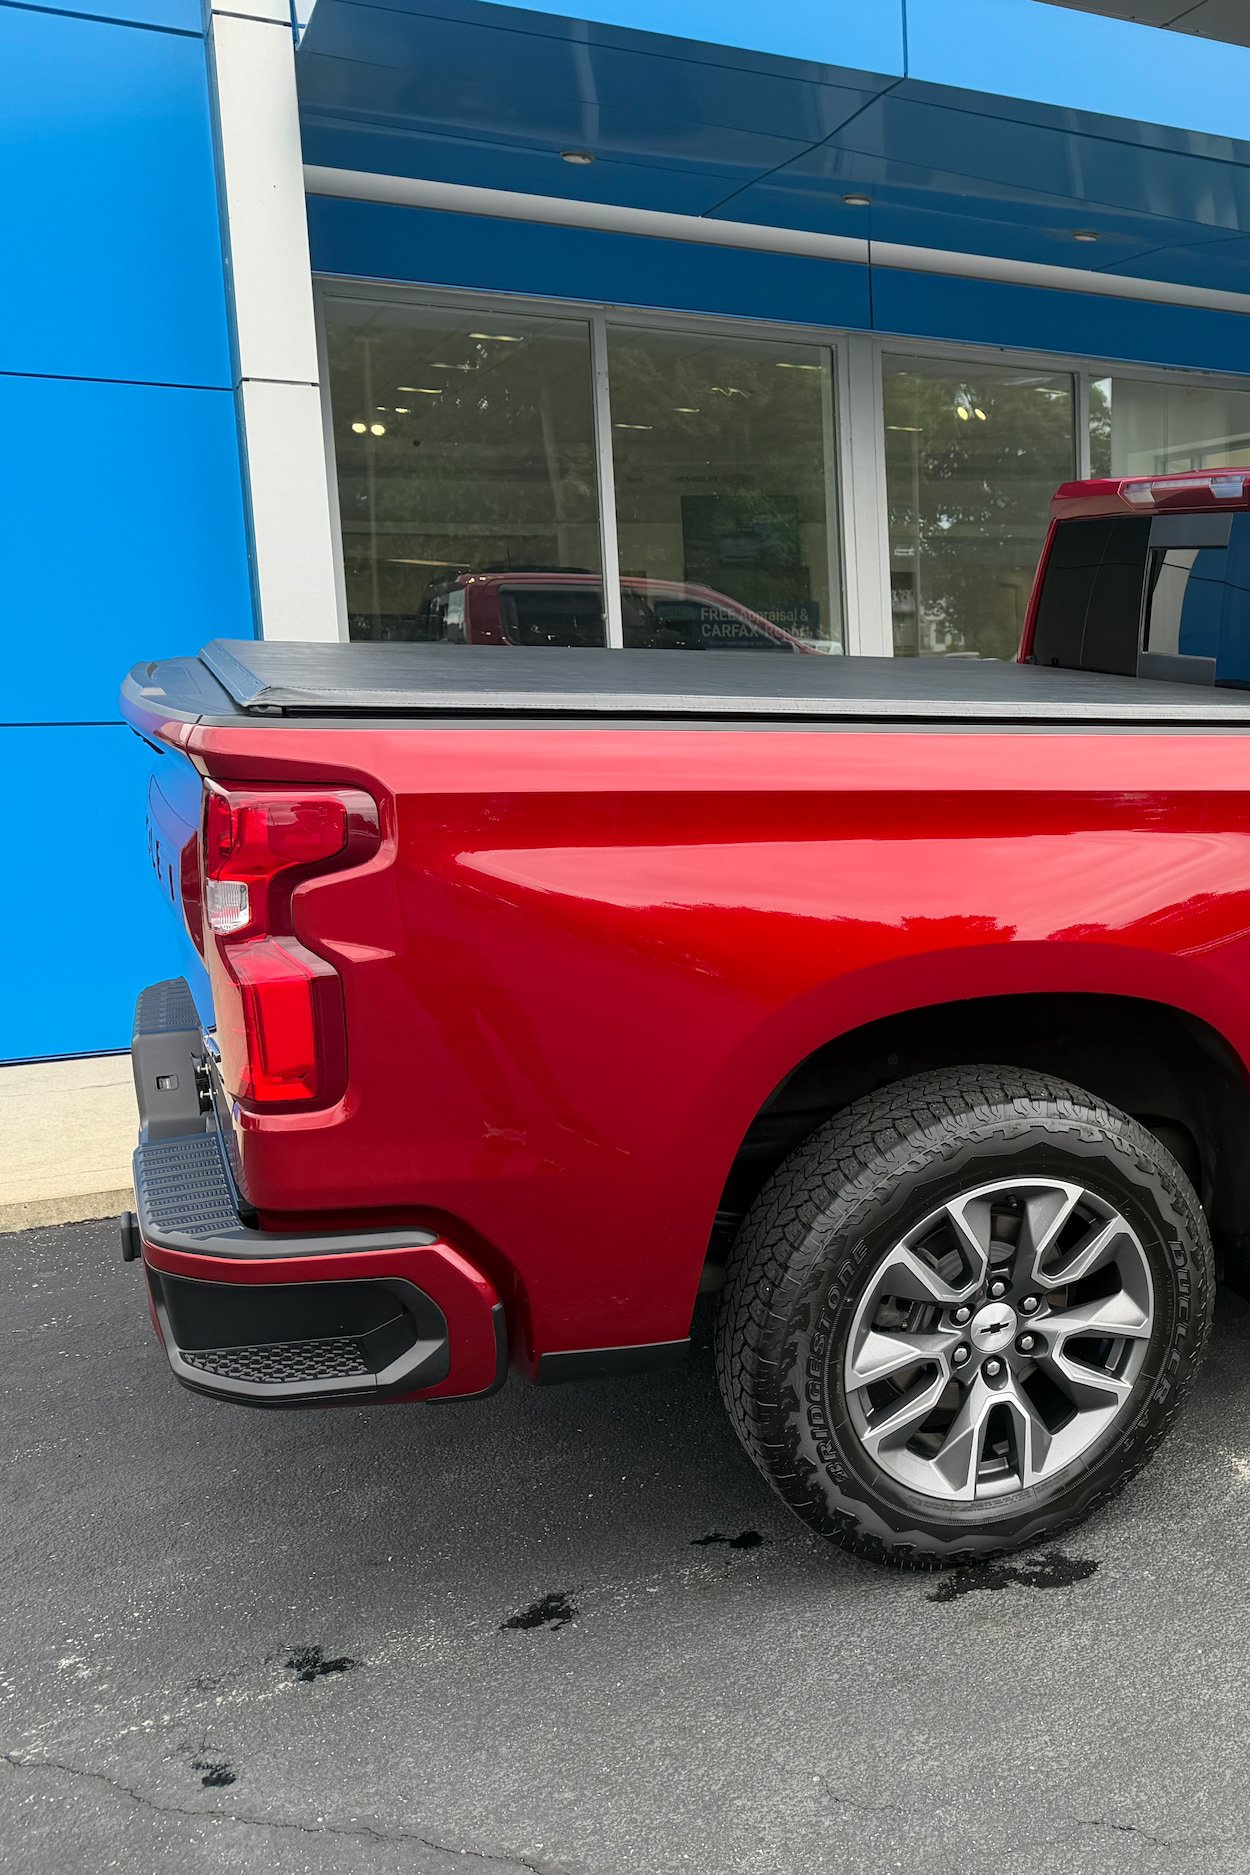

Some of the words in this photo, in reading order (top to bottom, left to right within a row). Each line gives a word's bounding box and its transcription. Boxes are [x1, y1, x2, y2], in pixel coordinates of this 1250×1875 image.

[701, 607, 737, 621] FREE
[799, 607, 809, 621] &
[701, 623, 759, 637] CARFAX
[806, 1238, 868, 1484] BRIDGESTONE
